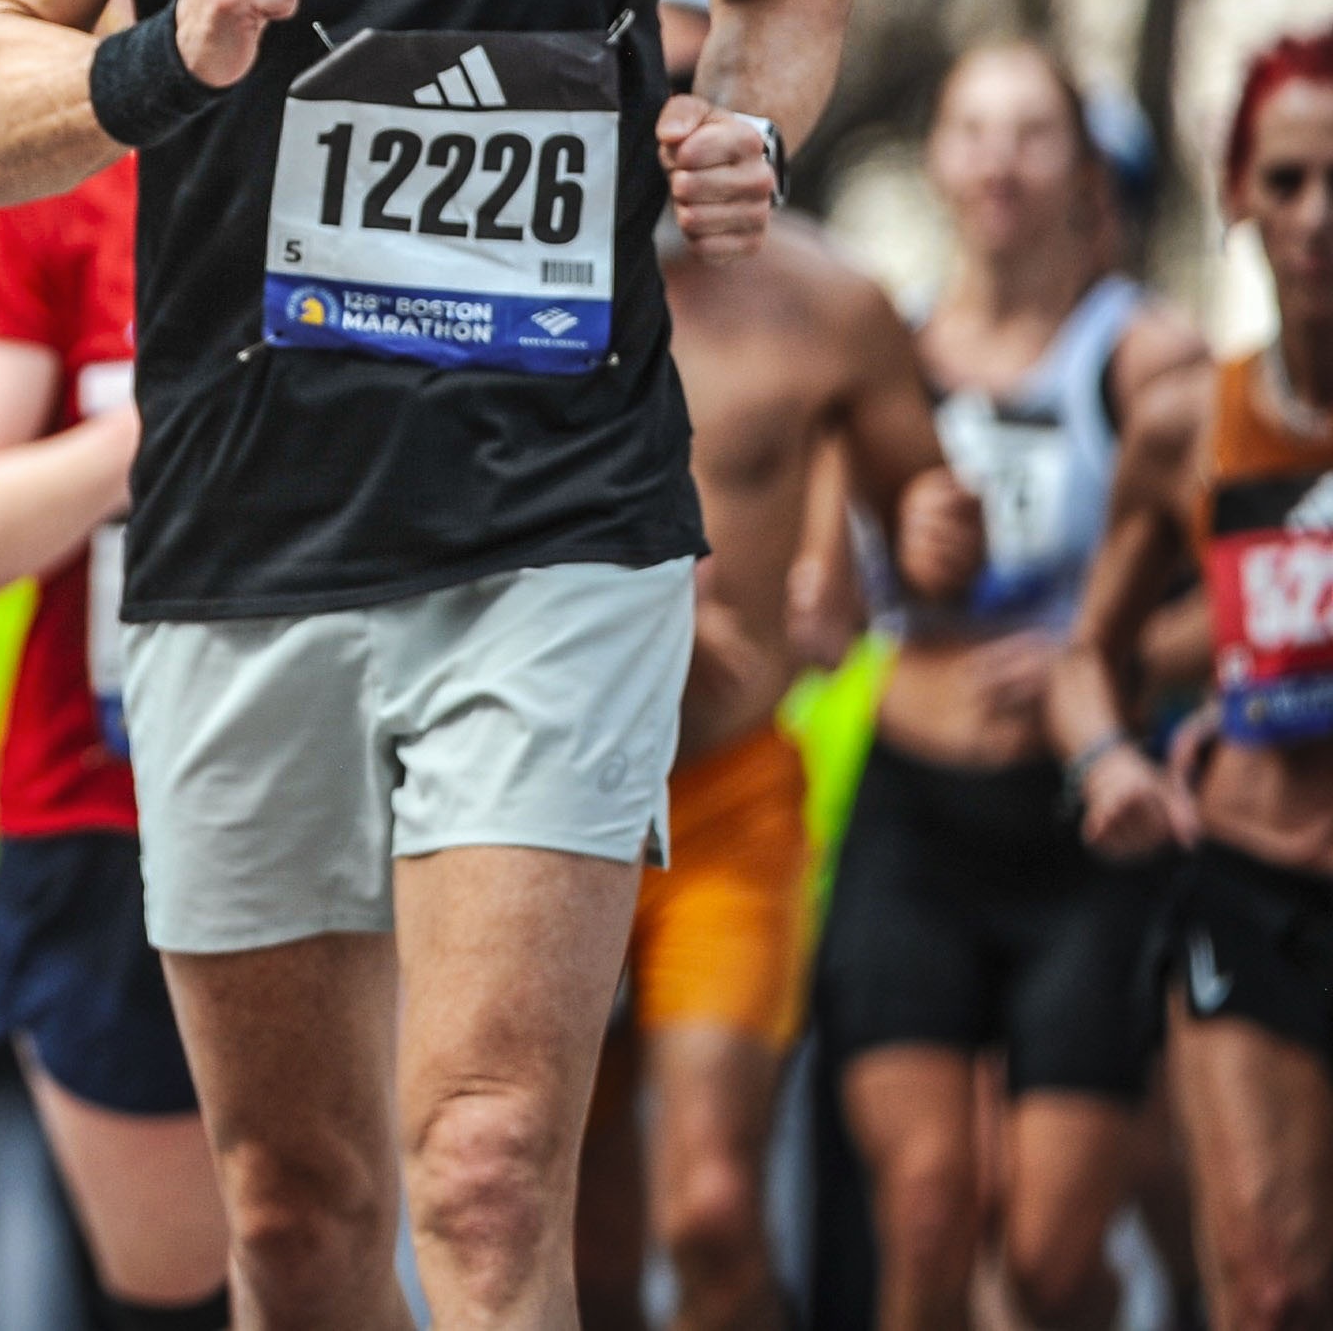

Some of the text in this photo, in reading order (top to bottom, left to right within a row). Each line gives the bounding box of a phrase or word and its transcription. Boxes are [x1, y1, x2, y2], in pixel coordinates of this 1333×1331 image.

[317, 123, 586, 245] 12226
[285, 239, 302, 263] 5
[395, 297, 493, 322] BOSTON
[342, 311, 493, 343] MARATHON
